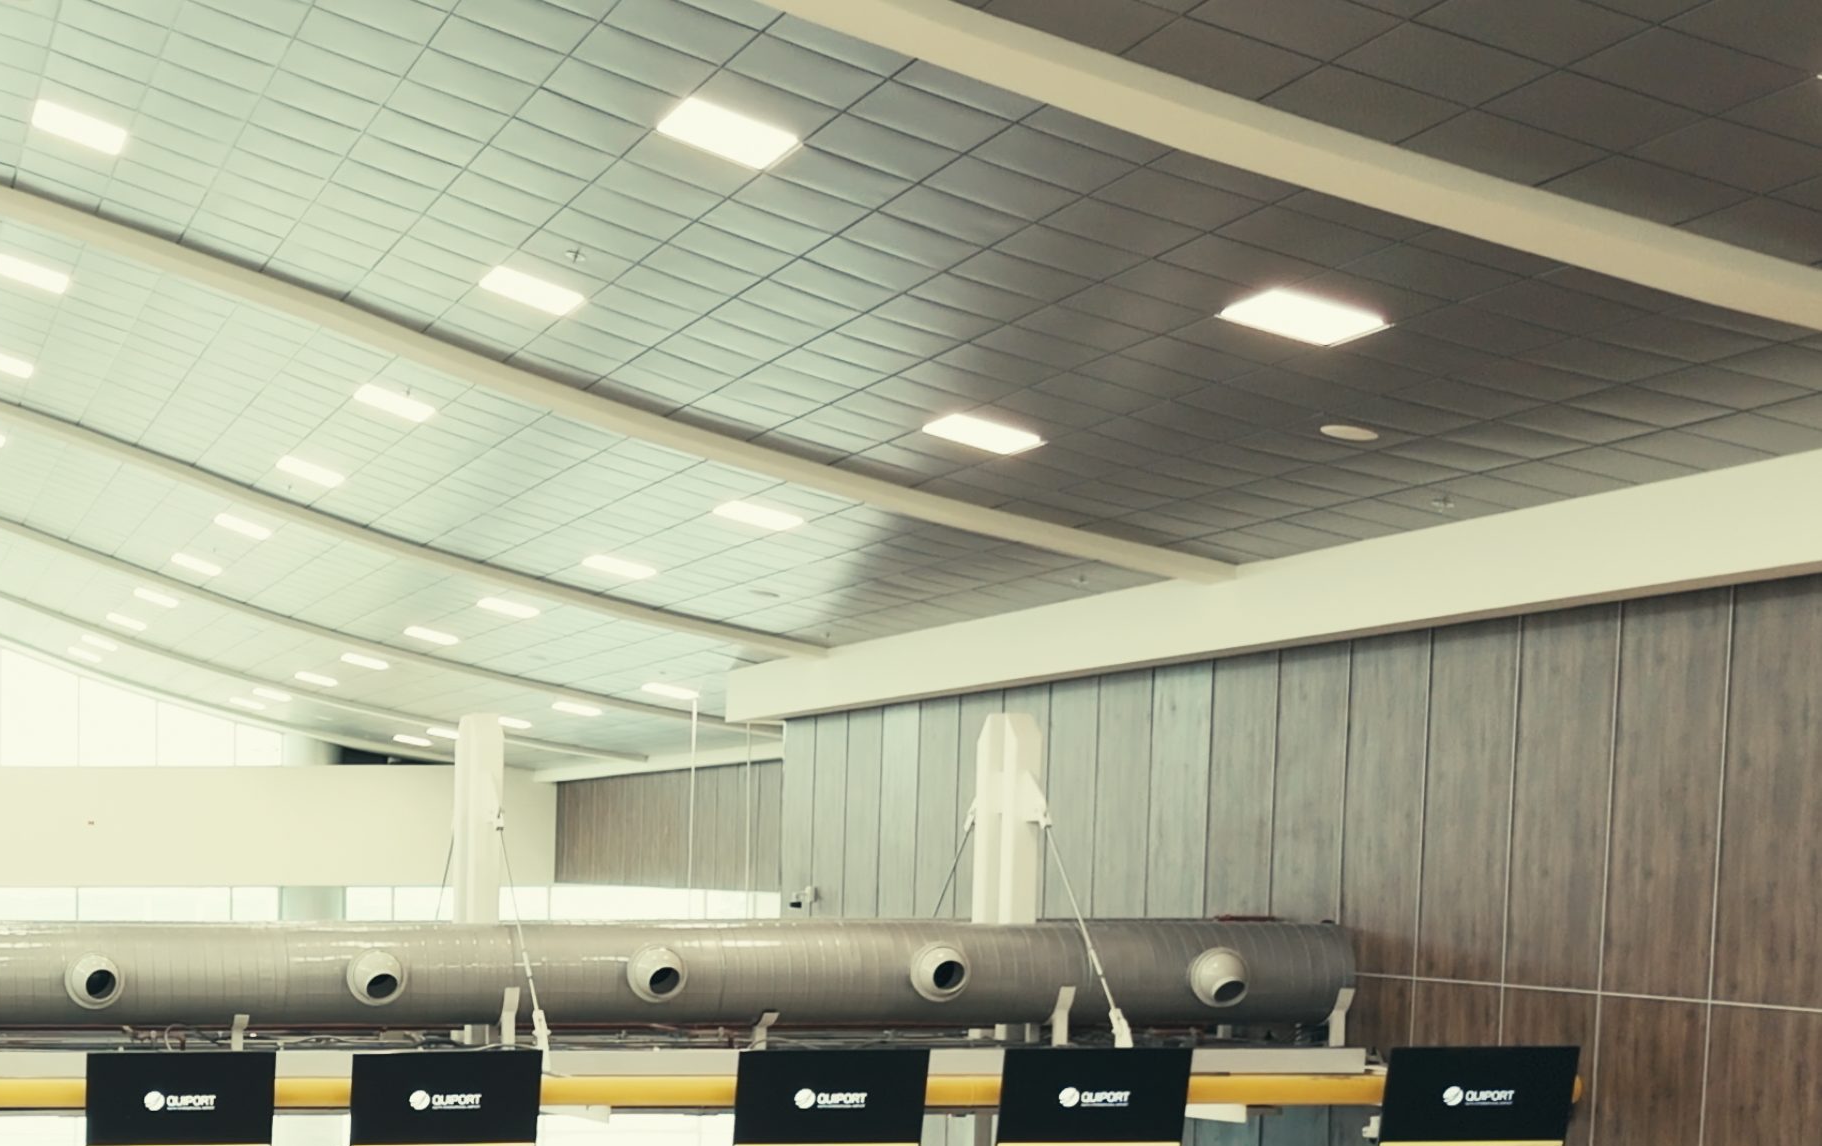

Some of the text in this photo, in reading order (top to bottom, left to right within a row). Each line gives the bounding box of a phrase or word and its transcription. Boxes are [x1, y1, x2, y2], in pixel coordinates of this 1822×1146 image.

[166, 1095, 217, 1107] QUIPORT
[431, 1093, 482, 1106] QUIPORT
[816, 1092, 868, 1105] QUIPORT
[1080, 1091, 1131, 1103] QUIPORT
[1465, 1090, 1515, 1102] QUIPORT
